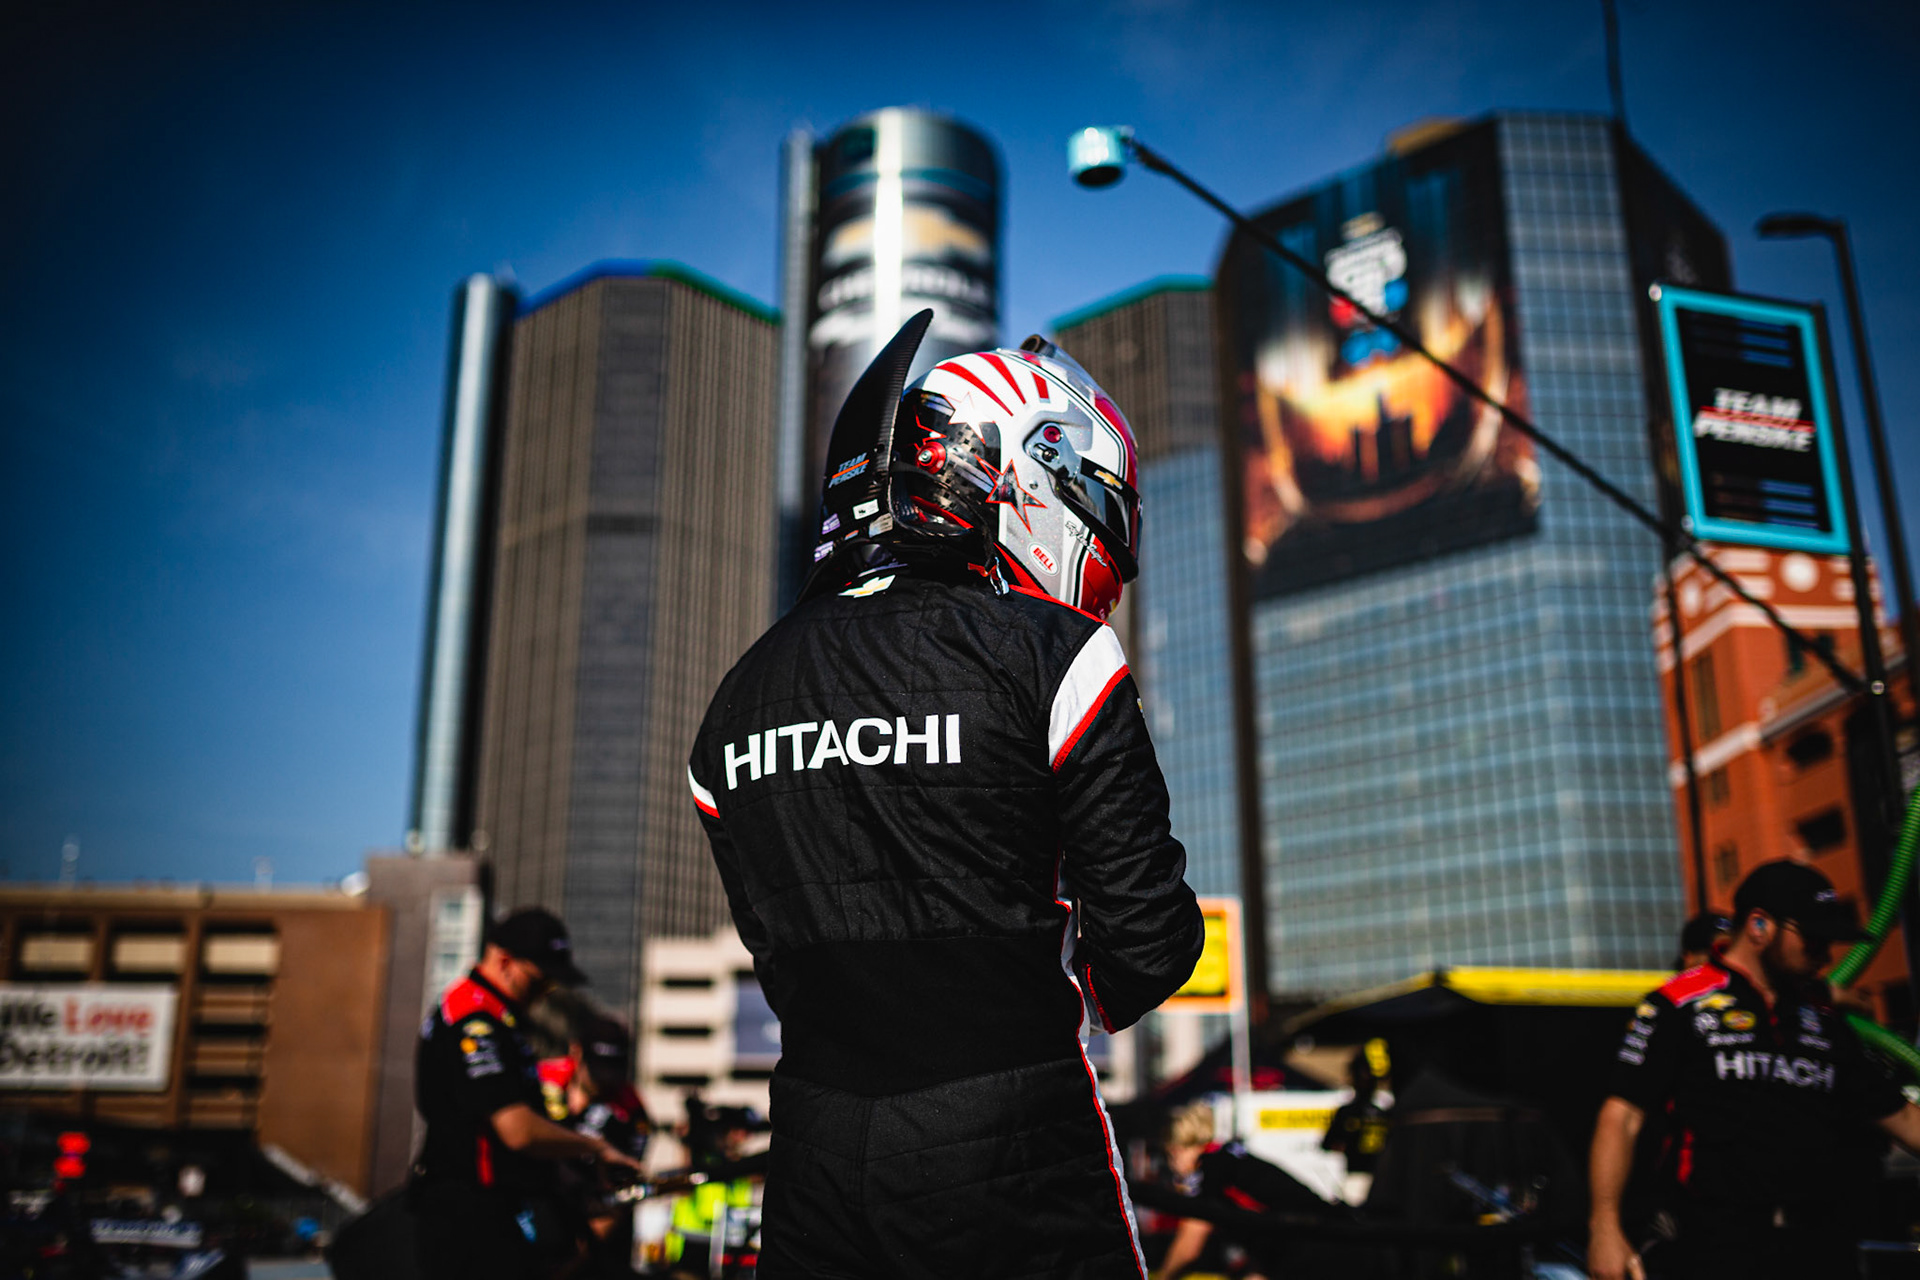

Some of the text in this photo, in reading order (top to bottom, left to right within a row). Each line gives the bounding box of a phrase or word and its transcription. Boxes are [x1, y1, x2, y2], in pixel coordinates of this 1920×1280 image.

[1714, 387, 1802, 419] TEAM
[1693, 409, 1815, 451] PENSKE
[839, 452, 867, 473] TEAM
[1032, 547, 1055, 572] BELL
[724, 713, 962, 791] HITACHI
[64, 995, 152, 1036] Love
[1715, 1050, 1835, 1091] HITACH
